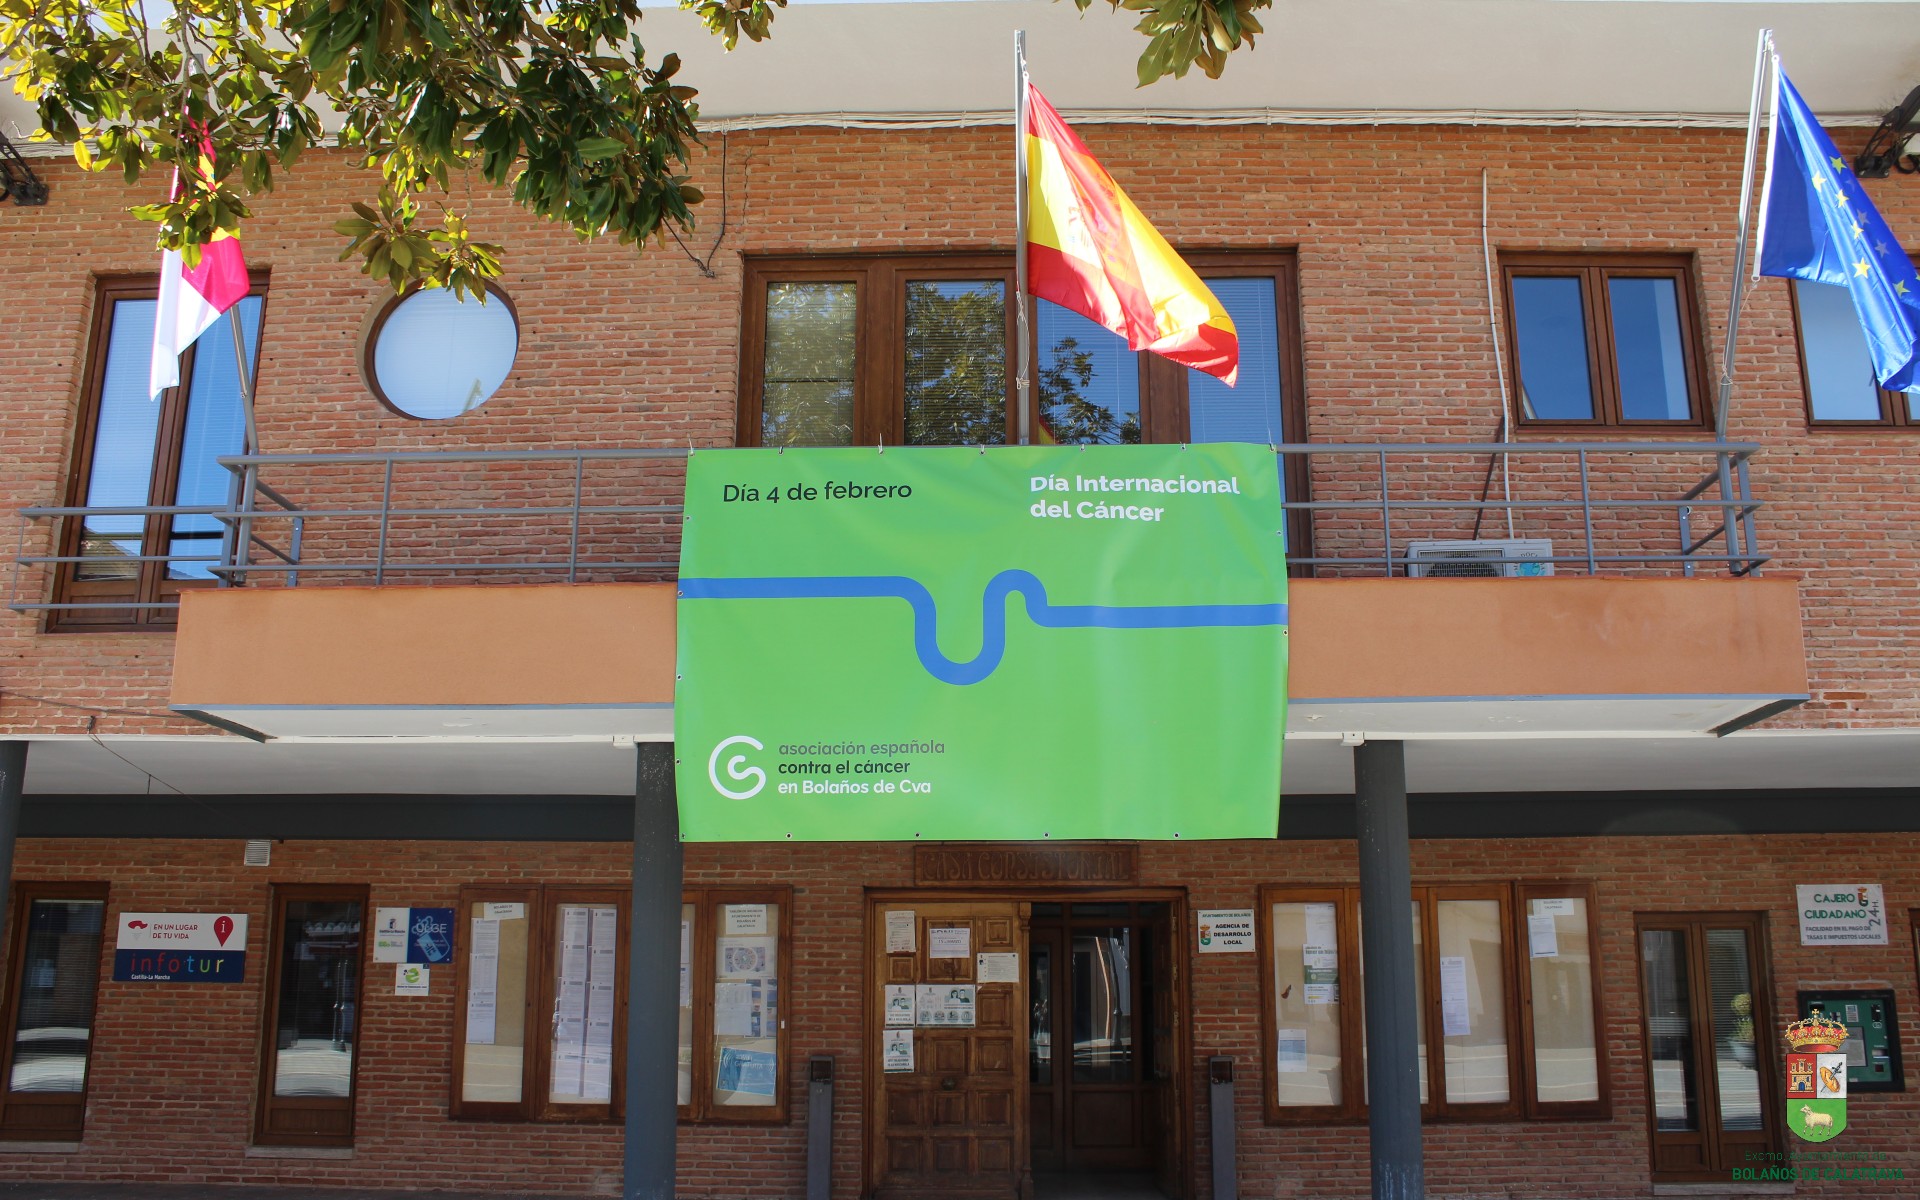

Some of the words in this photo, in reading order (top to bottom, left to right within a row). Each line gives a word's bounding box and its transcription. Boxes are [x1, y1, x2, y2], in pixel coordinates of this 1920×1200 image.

[724, 484, 759, 502] Día
[767, 487, 779, 503] 4
[787, 483, 817, 500] de
[824, 481, 912, 499] febrero
[1031, 474, 1070, 493] Día
[1076, 474, 1240, 495] Internacional
[1031, 500, 1071, 518] del
[1077, 500, 1164, 522] Cáncer
[778, 741, 866, 755] asociación
[871, 740, 945, 758] española
[778, 761, 831, 774] contra
[836, 760, 850, 774] el
[854, 759, 910, 774] cáncer
[778, 782, 798, 794] en
[803, 779, 868, 795] Bolaños
[874, 780, 895, 794] de
[900, 780, 931, 794] Cva
[923, 852, 973, 880] CASA
[1814, 893, 1855, 904] CAJERO
[1804, 909, 1867, 920] CIUDADANO
[130, 951, 225, 974] infotur
